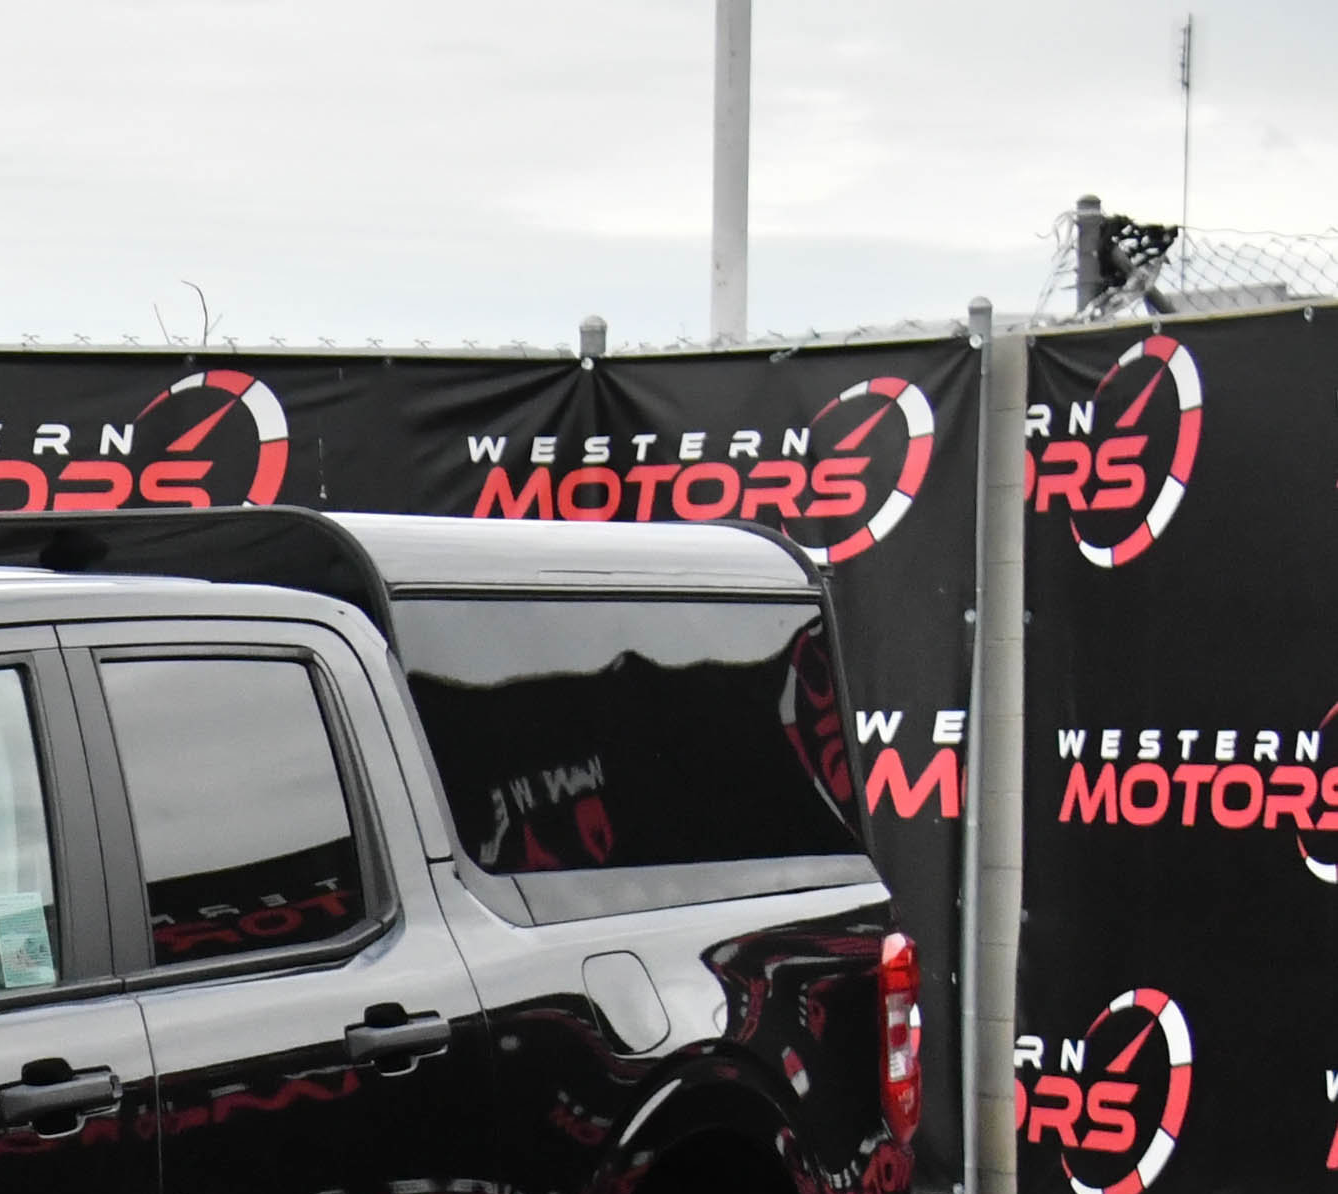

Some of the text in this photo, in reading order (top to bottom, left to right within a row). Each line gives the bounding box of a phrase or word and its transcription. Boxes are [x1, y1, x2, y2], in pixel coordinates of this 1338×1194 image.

[467, 427, 811, 463] WESTERN
[1024, 434, 1149, 513] RS
[472, 457, 871, 522] MOTORS
[1057, 729, 1321, 763] WESTERN
[1014, 1075, 1139, 1153] RS
